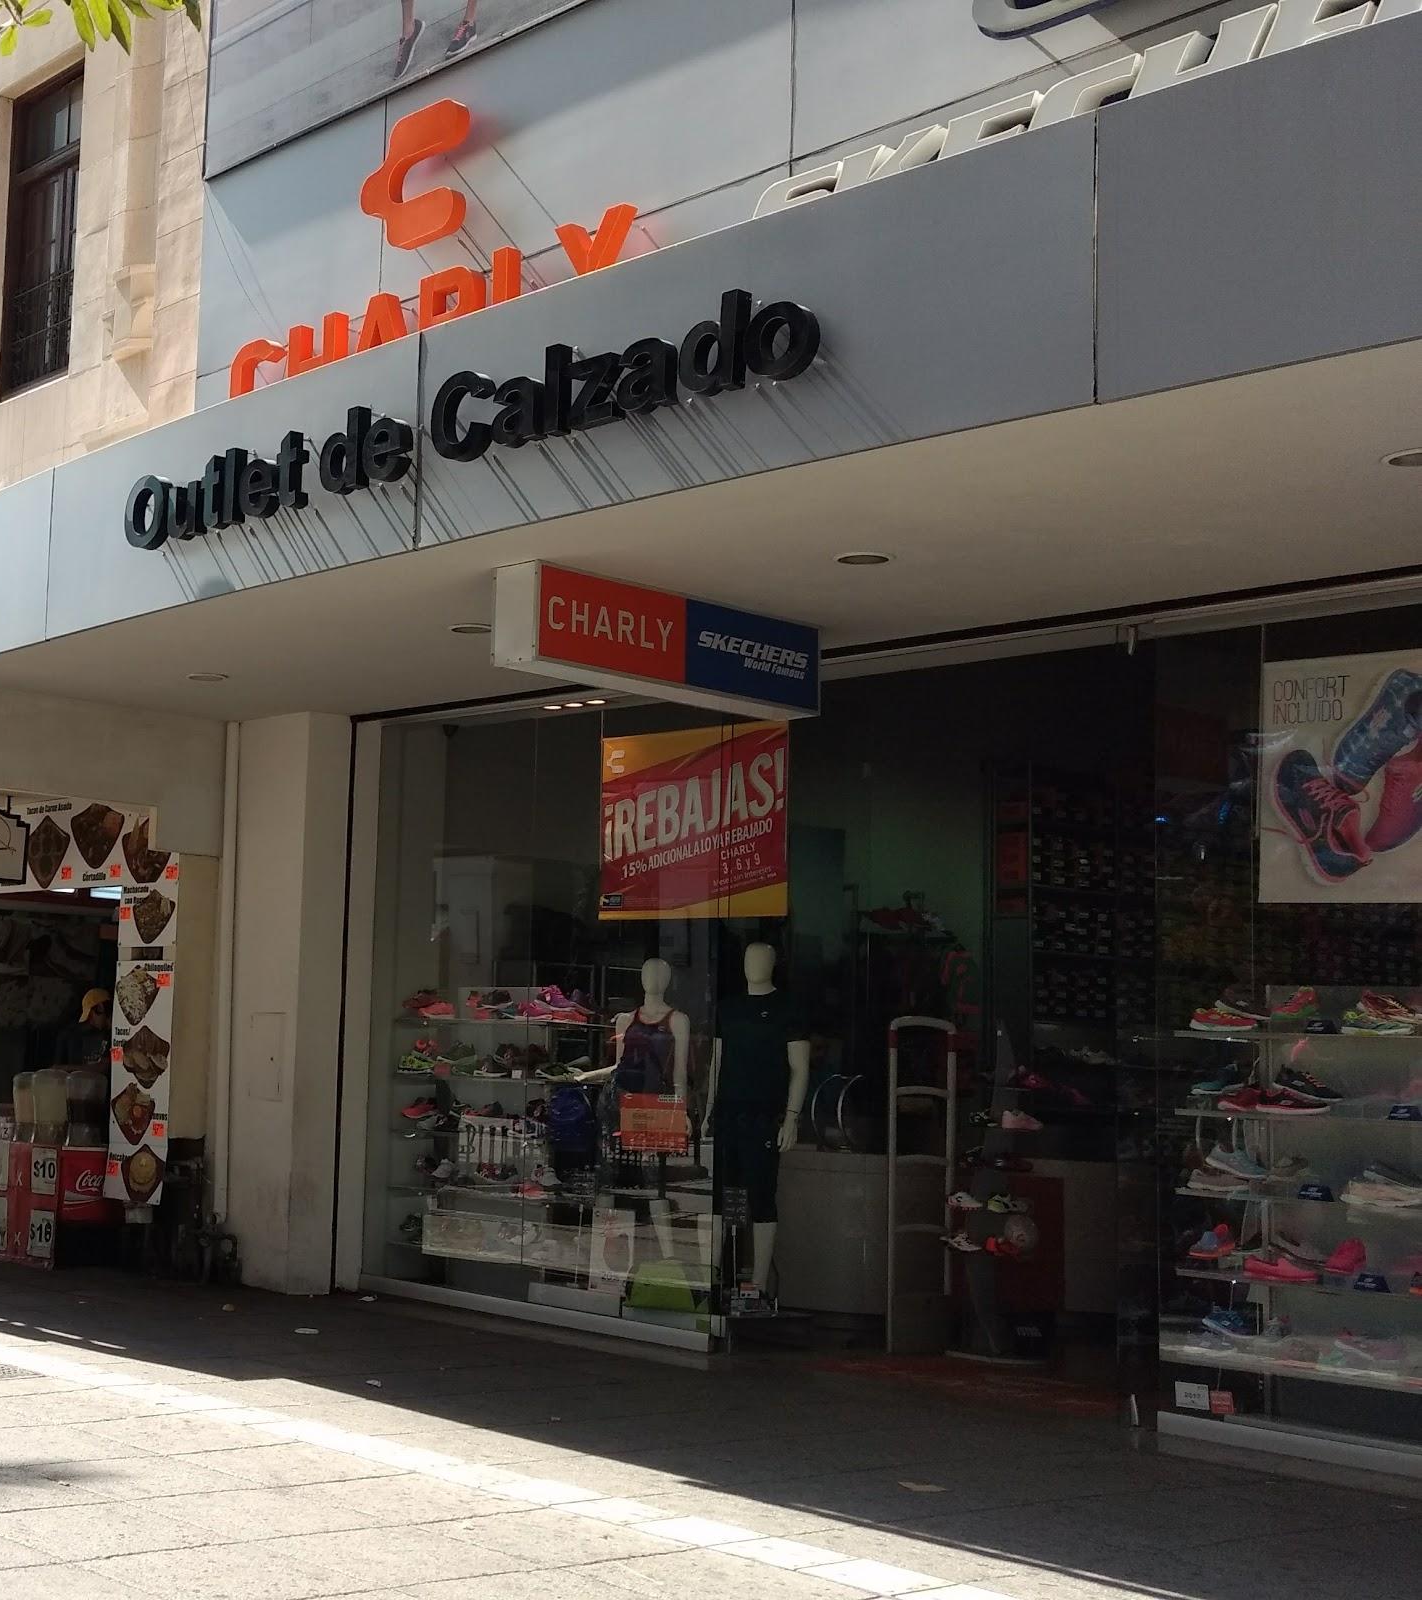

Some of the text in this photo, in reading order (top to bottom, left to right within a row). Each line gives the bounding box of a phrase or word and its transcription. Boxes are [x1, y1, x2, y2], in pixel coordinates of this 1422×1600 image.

[122, 288, 821, 552] Outlet de Calzado
[547, 595, 810, 669] CHARLY SKECHERS
[743, 657, 806, 681] World Famous
[1273, 675, 1351, 702] CONFORT
[1273, 699, 1343, 725] INCLUIDO
[603, 747, 786, 862] ¡REBAJAS!
[620, 861, 648, 880] 15%
[648, 847, 693, 869] ADICIONAL
[700, 837, 711, 854] LO
[724, 818, 773, 847] REBAJADO
[720, 841, 756, 860] CHARLY
[735, 858, 742, 870] 6
[753, 853, 761, 865] 9
[33, 1160, 56, 1179] $10
